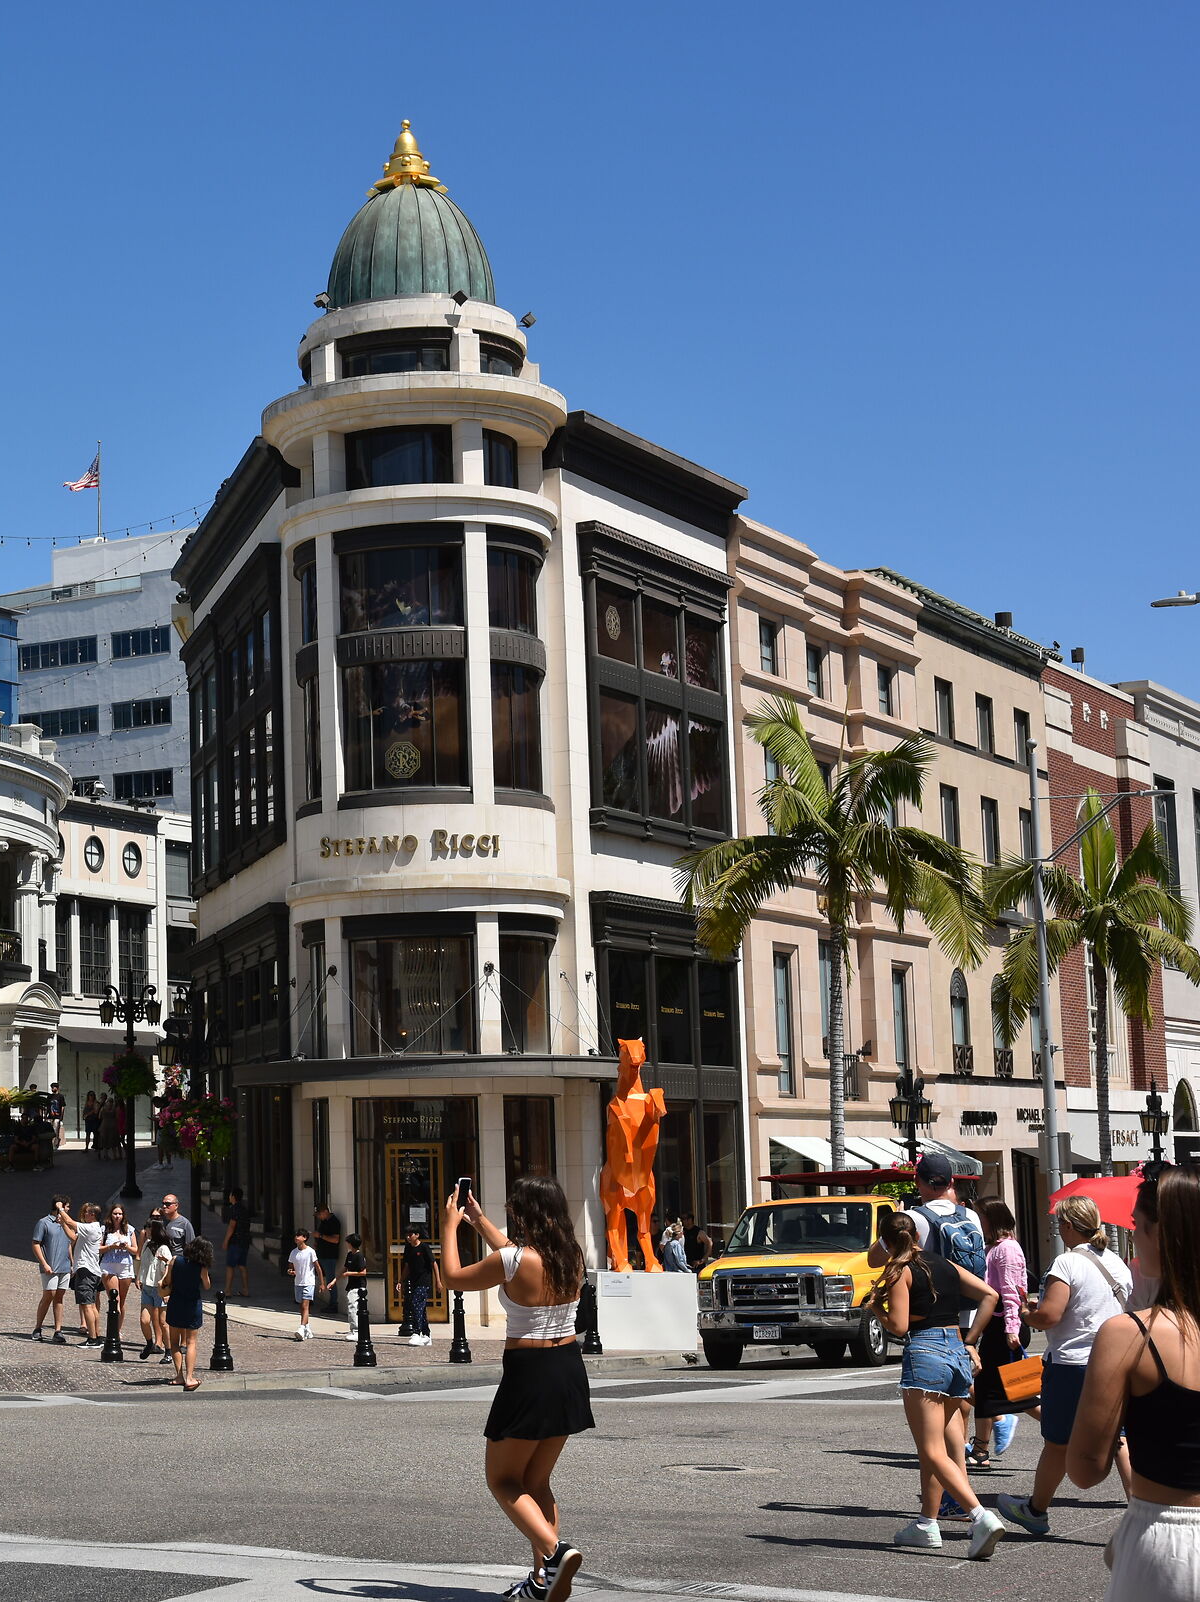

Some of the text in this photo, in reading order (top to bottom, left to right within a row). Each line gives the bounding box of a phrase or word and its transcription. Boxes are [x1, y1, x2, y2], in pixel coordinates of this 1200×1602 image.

[319, 829, 501, 859] STEFANO RICCI
[383, 1115, 442, 1124] STEFANO RICCI
[1111, 1129, 1138, 1146] ERSACE
